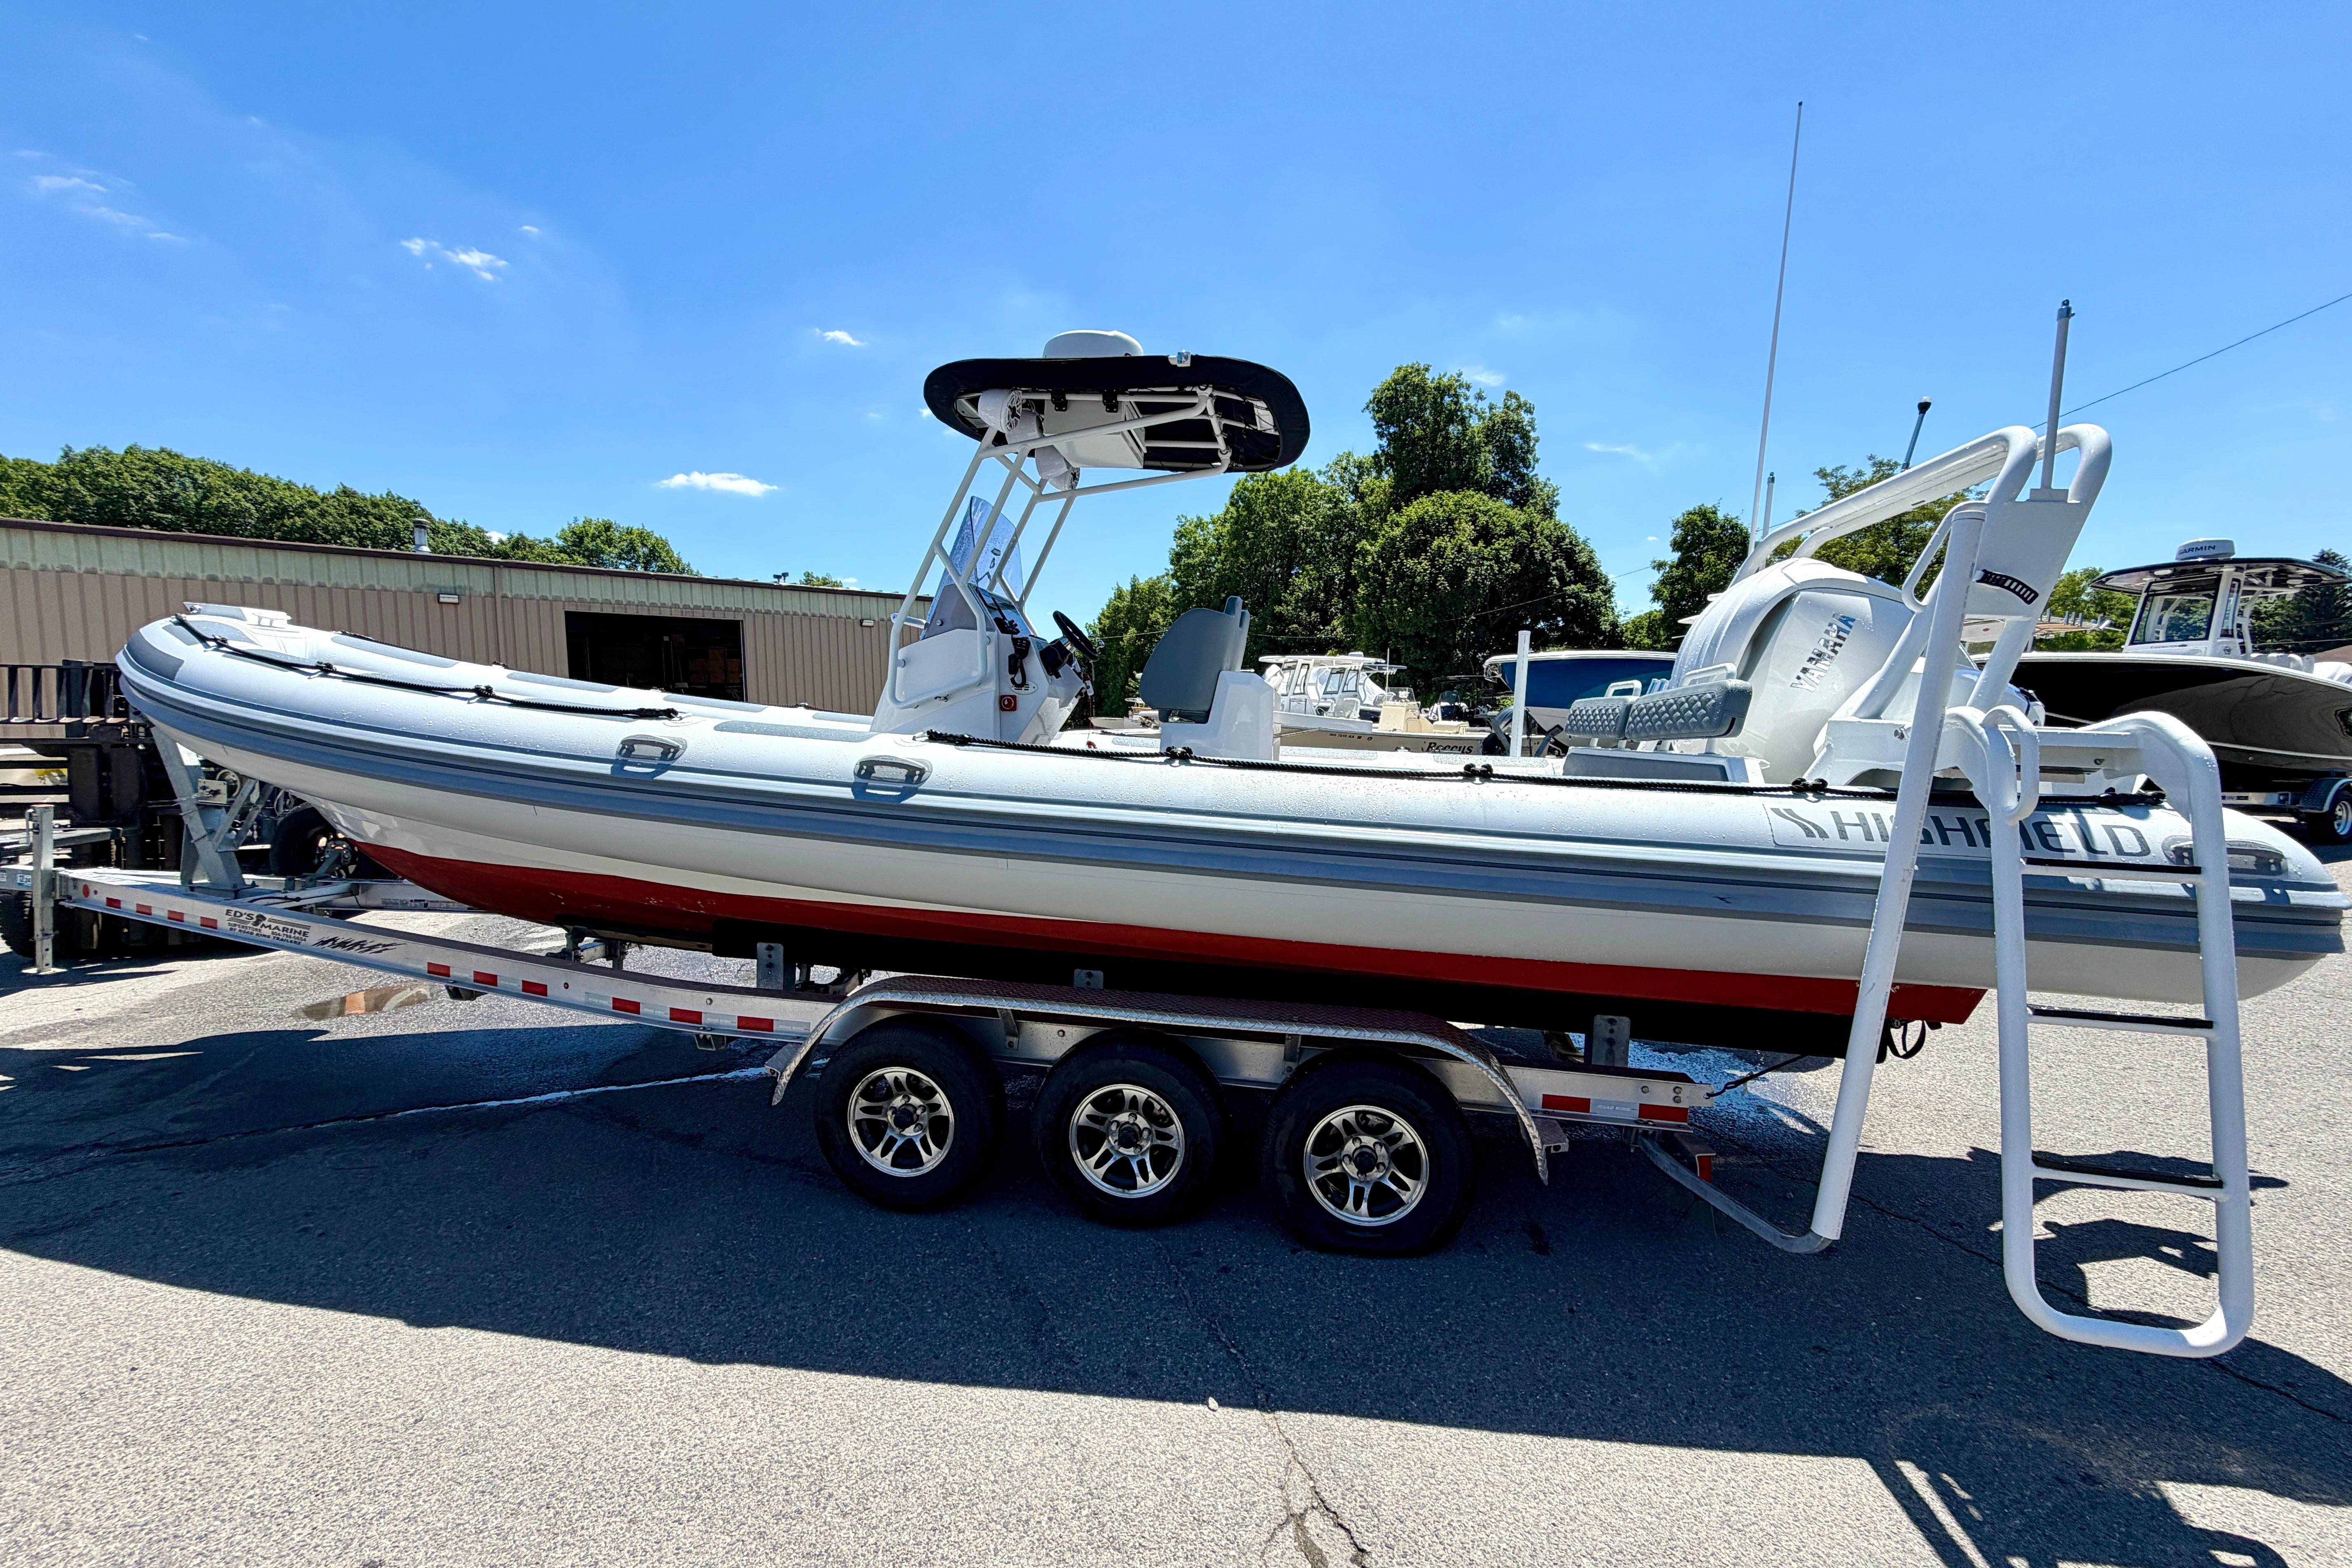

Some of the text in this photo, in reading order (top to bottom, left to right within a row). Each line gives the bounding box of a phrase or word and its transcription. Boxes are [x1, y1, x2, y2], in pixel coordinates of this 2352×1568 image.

[2178, 545, 2216, 555] GARMIN
[1790, 613, 1857, 693] YAMAHA
[225, 909, 254, 920] ED'S
[228, 922, 262, 933] SUPERSTORE
[260, 923, 310, 937] MARINE
[273, 936, 302, 945] TRAILERS
